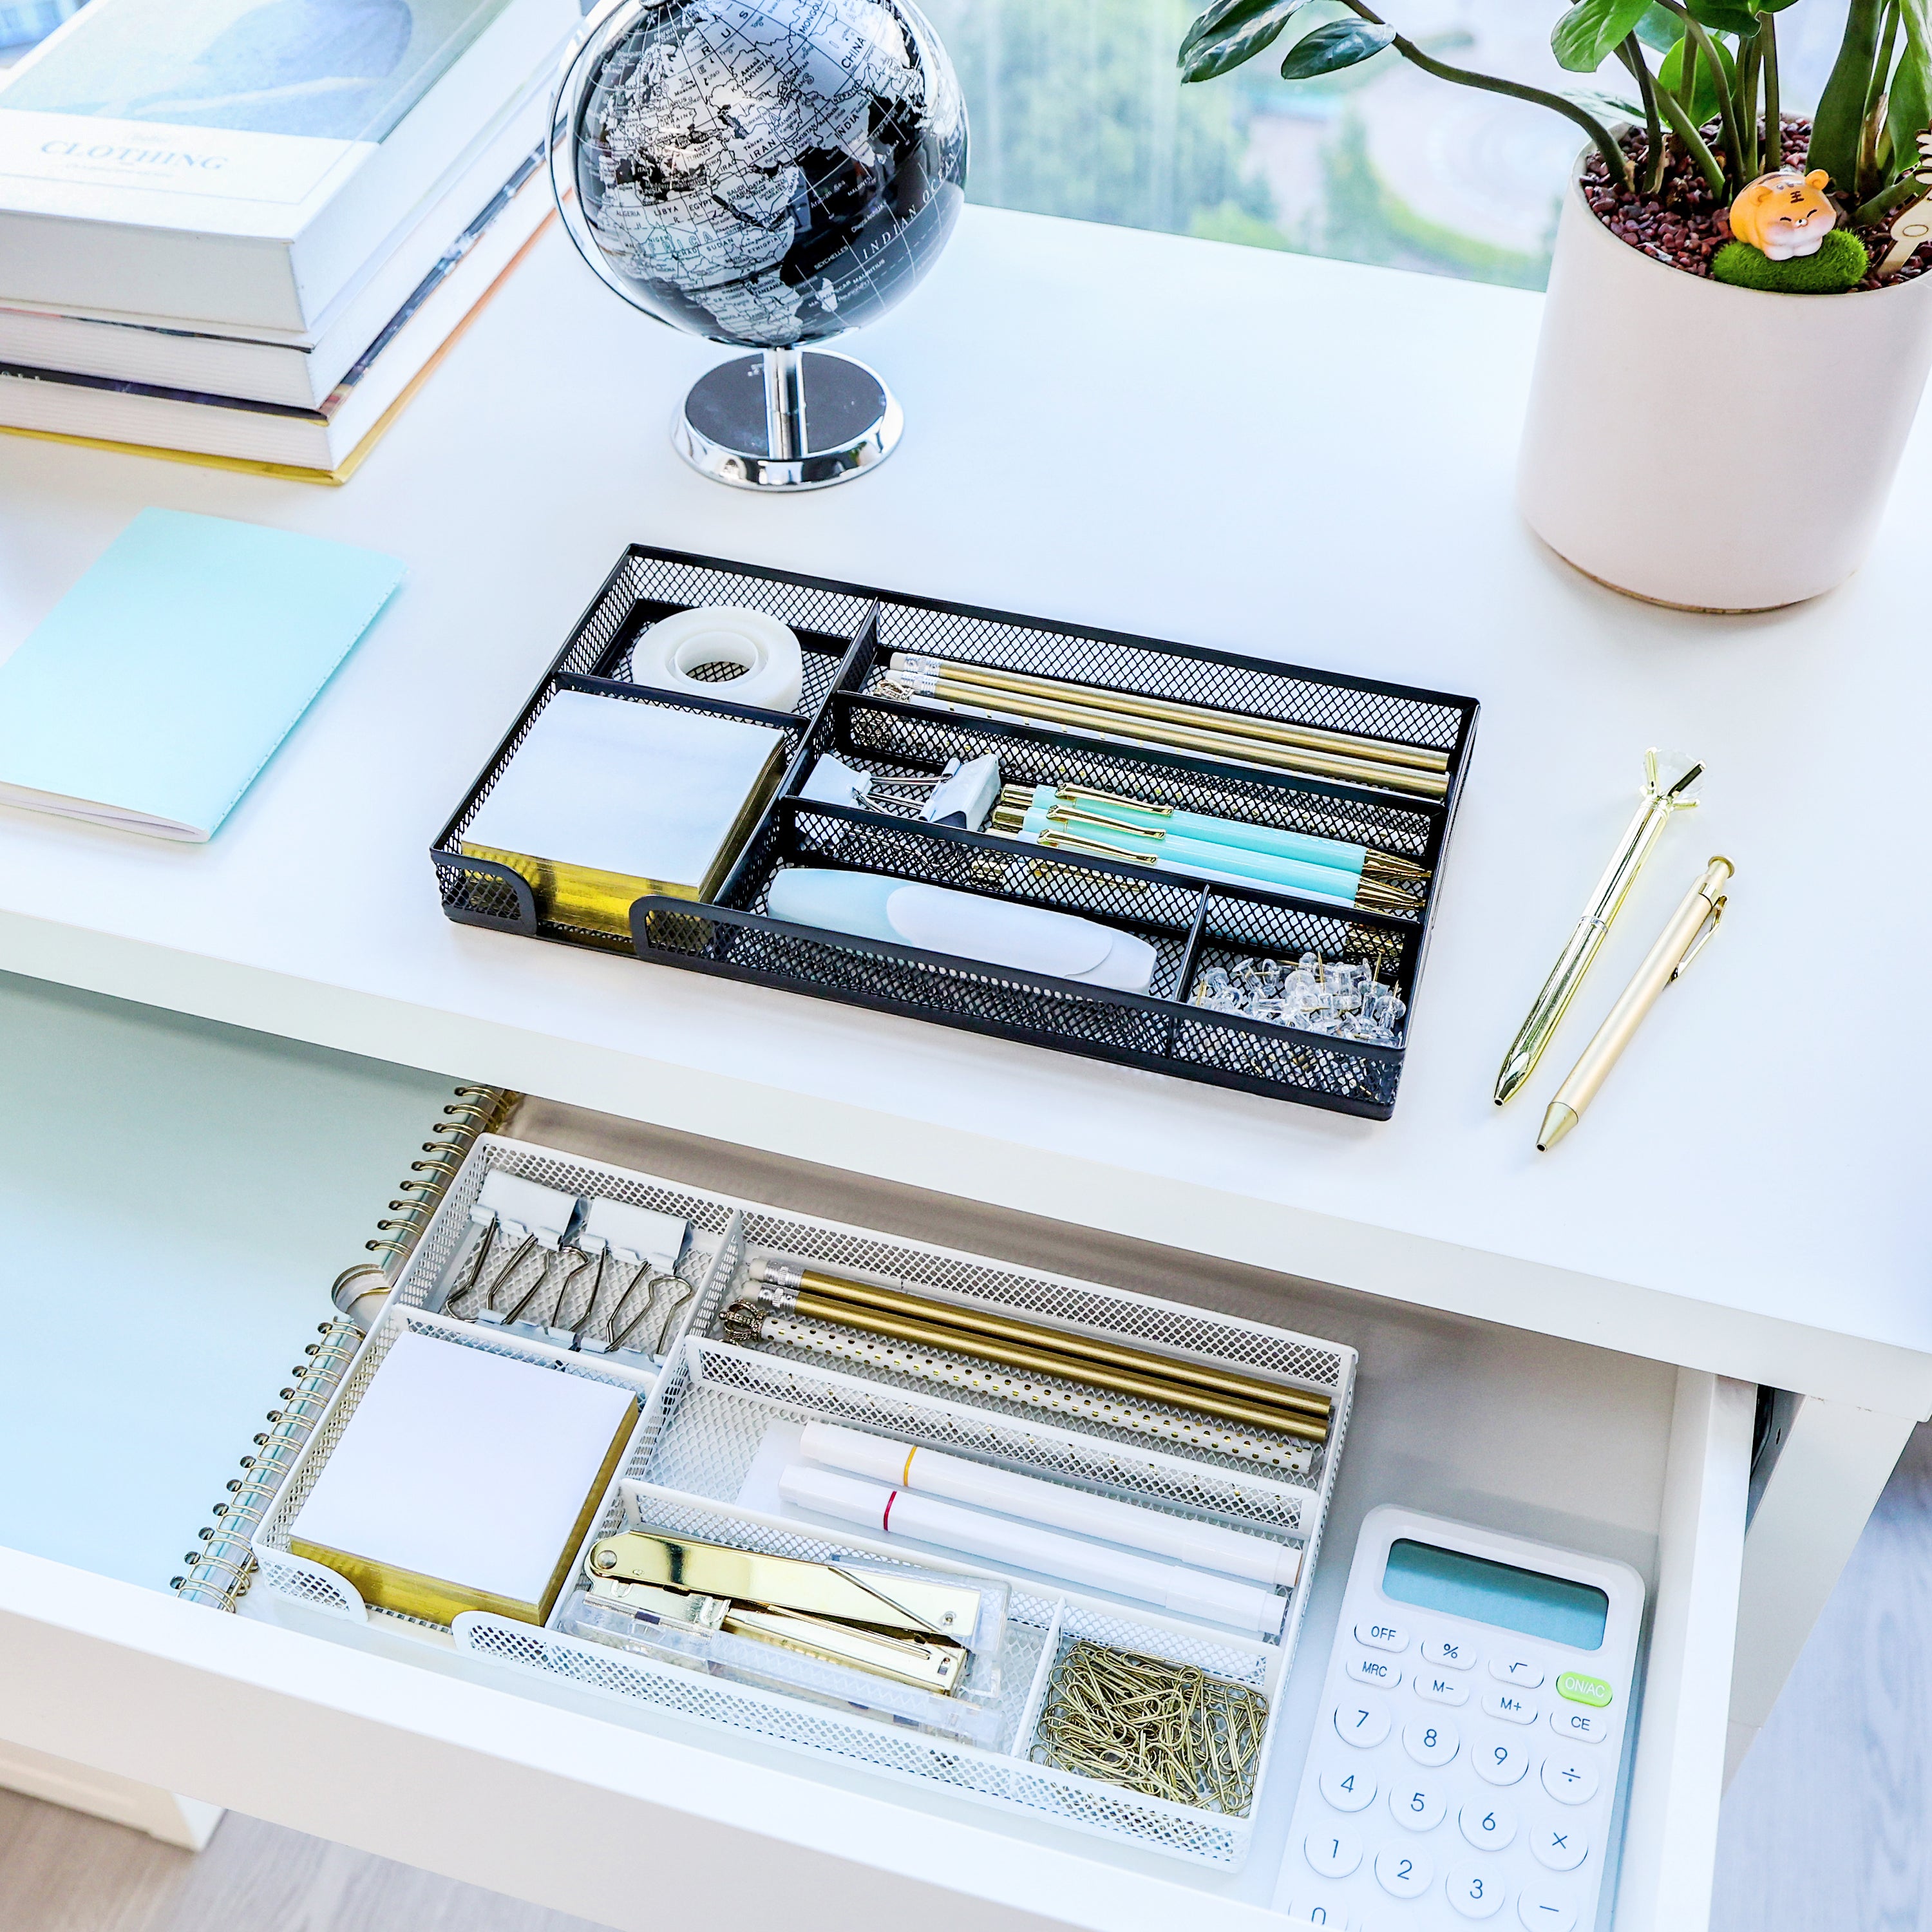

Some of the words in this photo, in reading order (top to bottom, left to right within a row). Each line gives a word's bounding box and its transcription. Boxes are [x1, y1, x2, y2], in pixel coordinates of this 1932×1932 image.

[841, 37, 866, 68] CHINA
[731, 54, 775, 93] KAZAKHSTAN
[674, 84, 696, 96] Moscow
[791, 122, 817, 146] PAKISTAN
[835, 113, 860, 139] INDIA
[743, 137, 764, 151] Tehran
[749, 138, 776, 160] IRAN
[40, 140, 229, 169] CLOTHING
[687, 147, 711, 162] TURKEY
[720, 159, 737, 172] IRAQ
[726, 183, 745, 195] SAUDI
[750, 176, 766, 191] QATAR
[788, 171, 797, 193] OMAN
[728, 189, 750, 204] ARABIA
[765, 184, 786, 201] EMIRATES
[810, 190, 833, 208] Arabian
[833, 180, 846, 193] Sea
[654, 205, 679, 216] LIBYA
[688, 198, 713, 211] EGYPT
[862, 204, 917, 260] INDIAN
[677, 246, 698, 258] CHAD
[706, 237, 734, 252] SUDAN
[748, 237, 778, 254] ETHIOPIA
[814, 245, 849, 270] SEYCHELLES
[1371, 1625, 1396, 1640] OFF
[1443, 1643, 1459, 1658] %
[1362, 1661, 1387, 1677] MRC
[1564, 1676, 1606, 1698] ON/AC
[1501, 1697, 1522, 1711] M+
[1356, 1710, 1369, 1727] 7
[1571, 1716, 1591, 1731] CE
[1424, 1728, 1437, 1747] 8
[1494, 1747, 1508, 1765] 9
[1340, 1775, 1354, 1794] 4
[1410, 1793, 1425, 1812] 5
[1482, 1812, 1496, 1831] 6
[1331, 1839, 1340, 1859] 1
[1397, 1859, 1412, 1880] 2
[1470, 1879, 1483, 1899] 3
